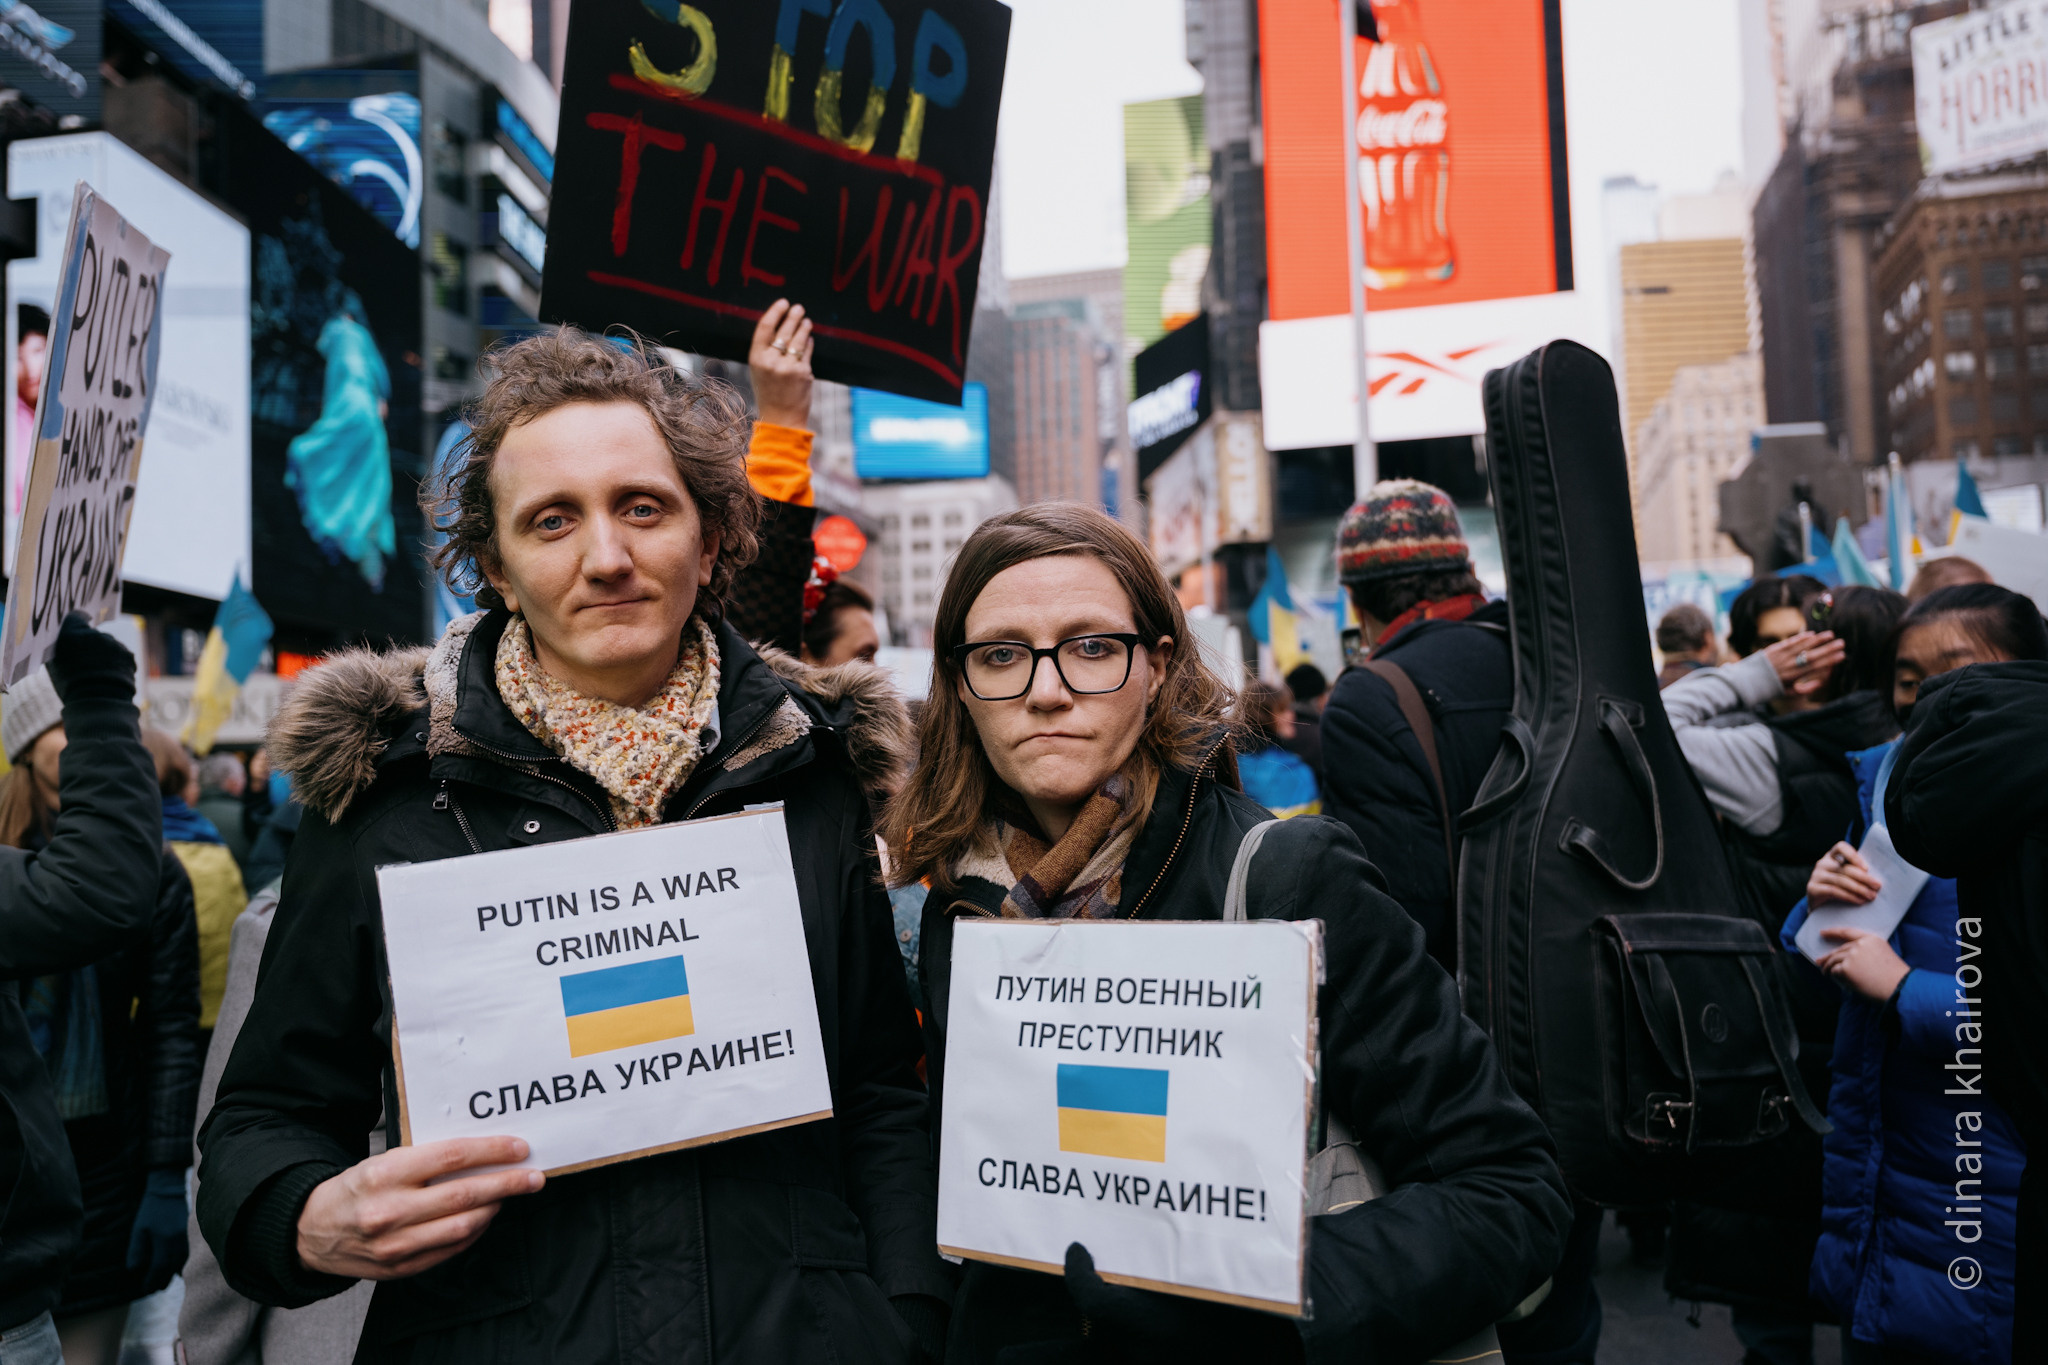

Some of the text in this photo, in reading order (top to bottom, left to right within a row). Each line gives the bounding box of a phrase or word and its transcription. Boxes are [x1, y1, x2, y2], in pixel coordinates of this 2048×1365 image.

[1939, 10, 2028, 70] LITTLE
[628, 0, 968, 177] STOP
[586, 111, 808, 287] THE
[831, 185, 982, 367] WAR
[60, 229, 158, 399] PUTLER
[55, 402, 113, 494] HANDS
[110, 417, 138, 480] OFF
[31, 485, 135, 637] UKRAINE
[477, 867, 740, 932] PUTIN IS A WAR
[536, 918, 700, 966] CRIMINAL
[995, 974, 1263, 1009] ПУТИН ВОЕННЫЙ
[468, 1029, 795, 1120] СЛАВА УКРАИНЕ!
[1018, 1021, 1223, 1058] ПРЕСТУПНИК
[978, 1157, 1267, 1222] СЛАВА УКРАИНЕ!
